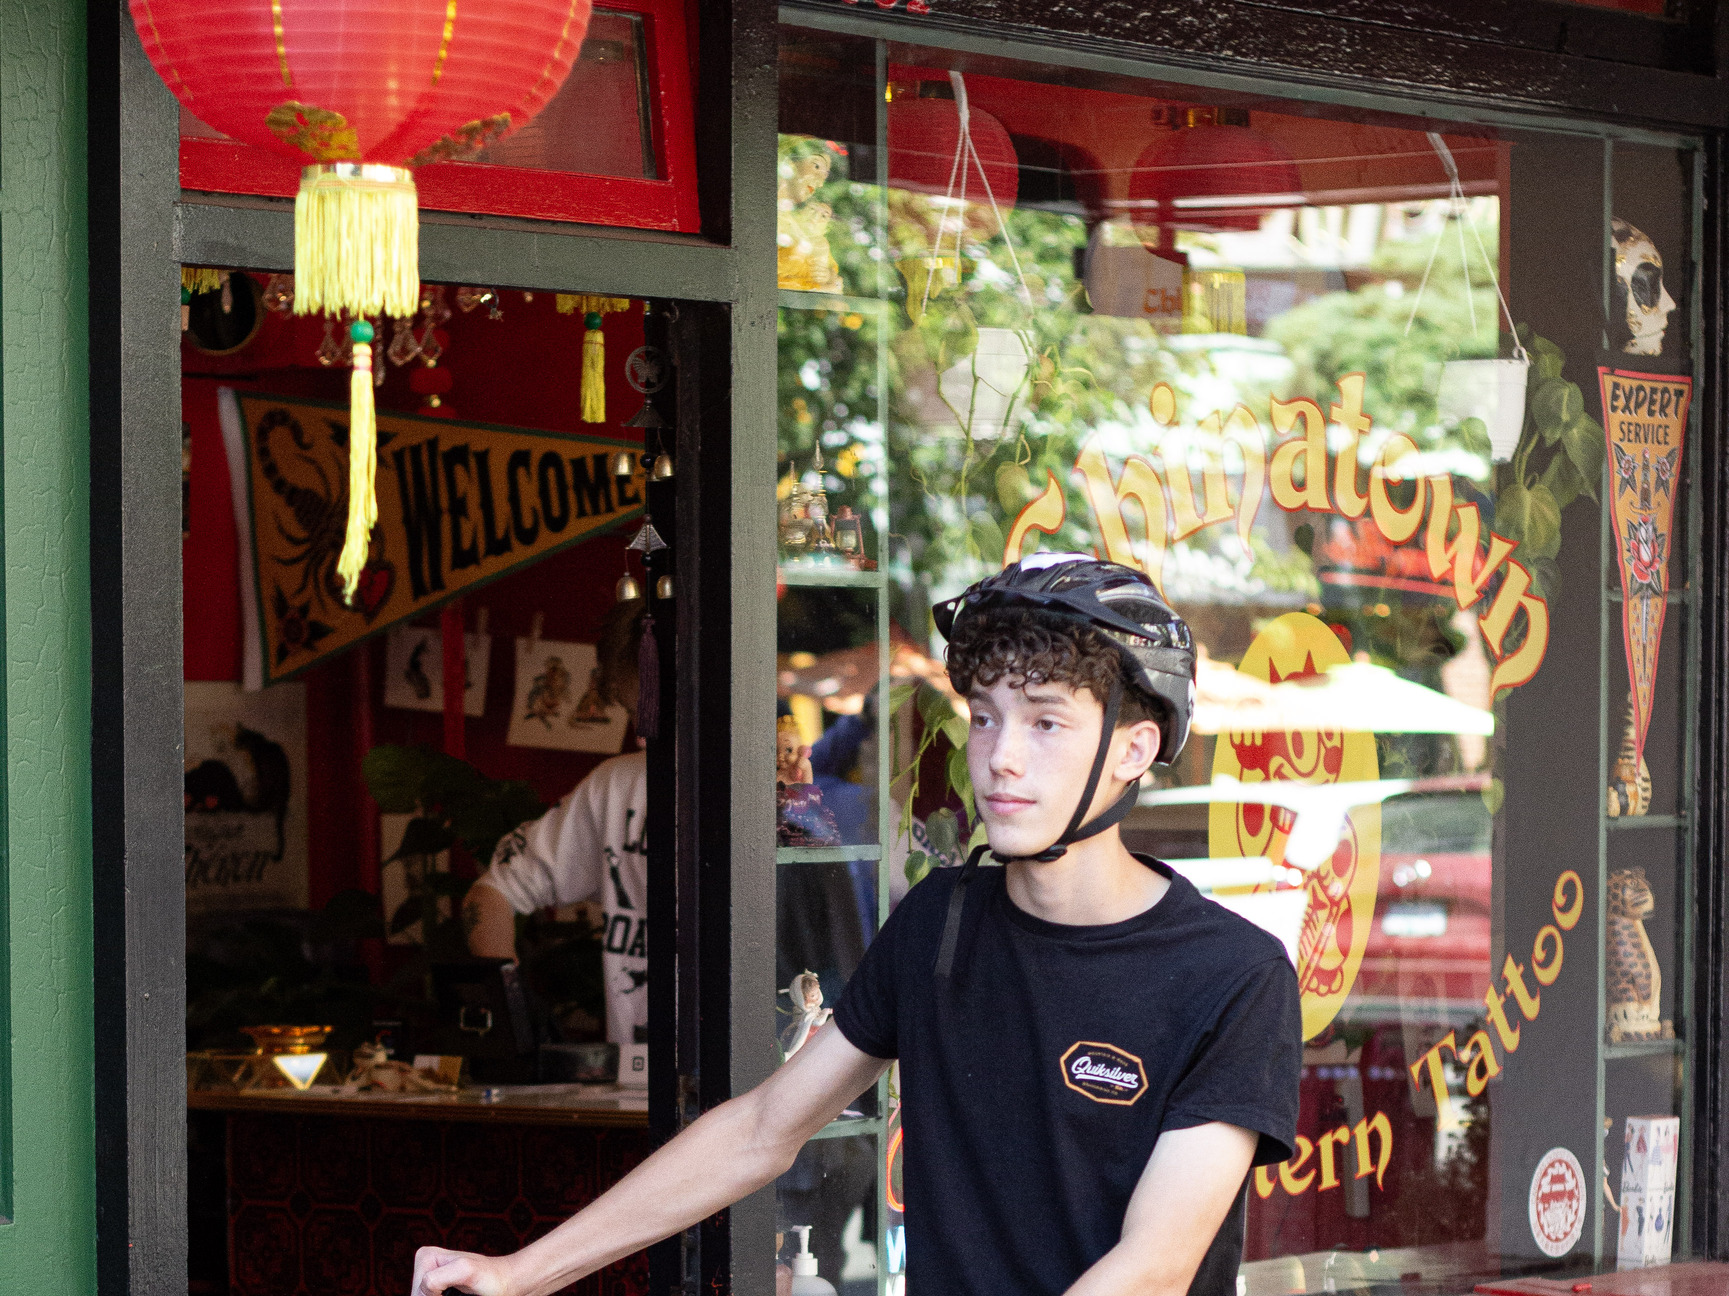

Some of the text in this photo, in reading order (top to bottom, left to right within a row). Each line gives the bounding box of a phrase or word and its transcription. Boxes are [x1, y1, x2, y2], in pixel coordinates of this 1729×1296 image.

[1609, 380, 1685, 420] EXPERT
[1619, 420, 1670, 446] SERVICE
[391, 435, 642, 602] WELCOME
[1254, 869, 1584, 1200] tern Tattoo
[1071, 1055, 1139, 1087] Quiksilver
